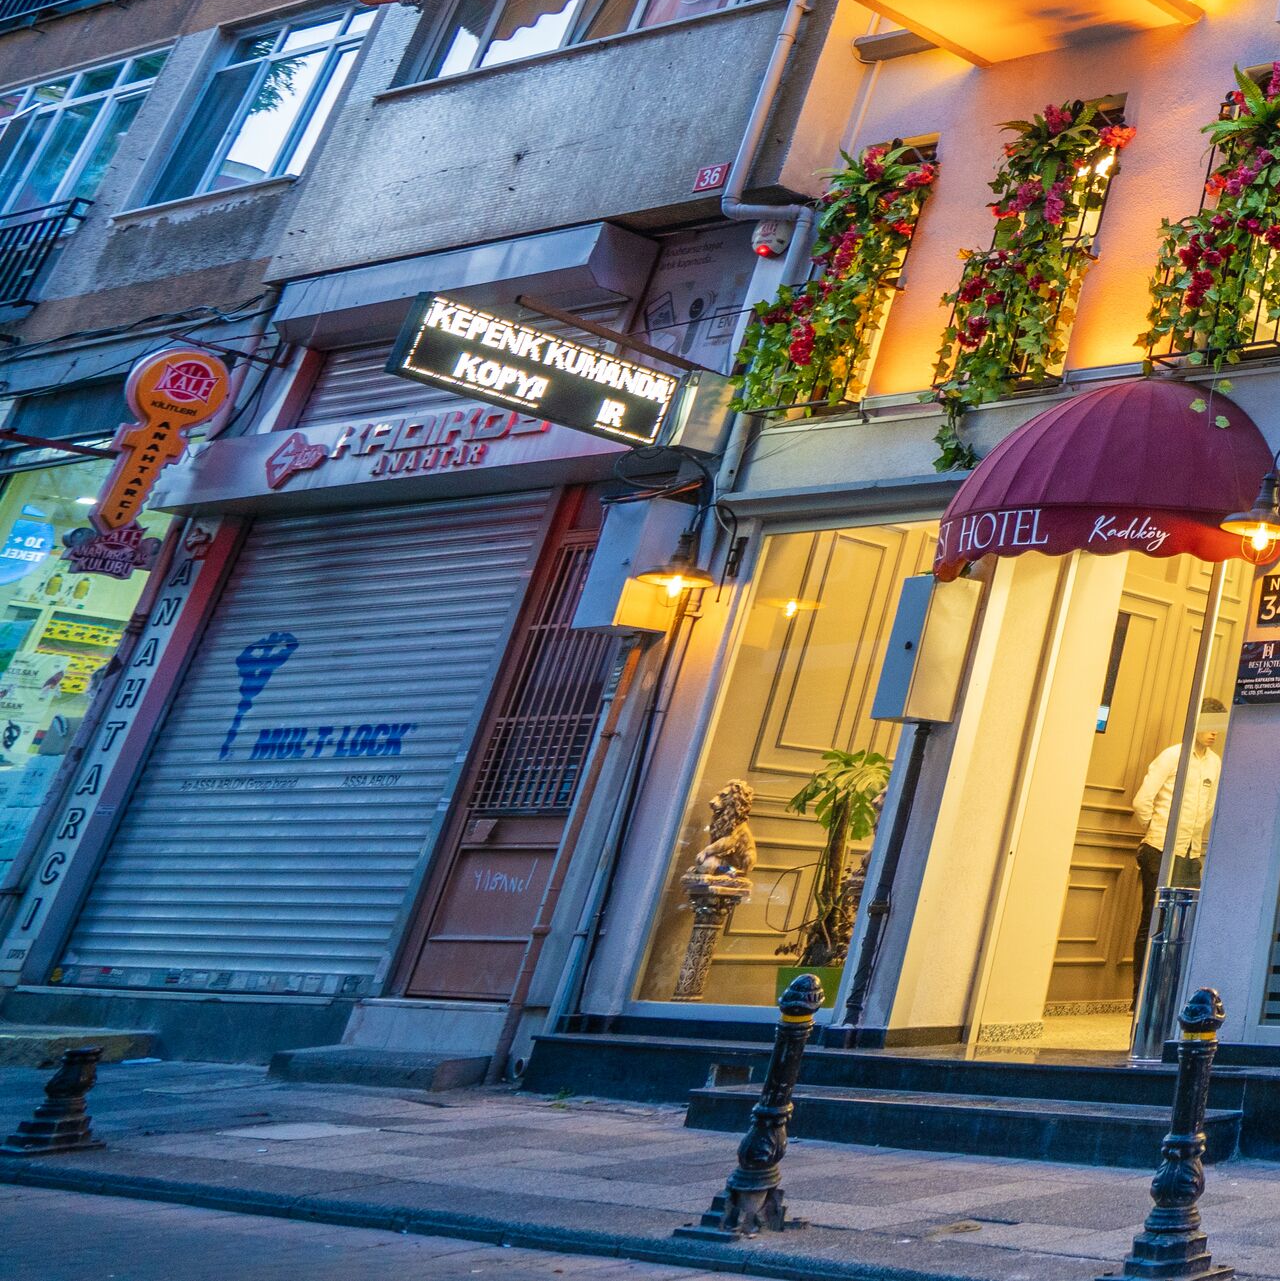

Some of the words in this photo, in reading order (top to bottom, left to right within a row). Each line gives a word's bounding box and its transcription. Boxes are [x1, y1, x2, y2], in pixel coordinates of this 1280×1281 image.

[700, 167, 721, 187] 36
[427, 302, 543, 363] KEPENK
[543, 341, 669, 403] KUMANDA
[159, 369, 216, 401] KALE
[115, 421, 170, 520] ANAHTARCI
[371, 443, 488, 476] ANAHTAR
[958, 509, 1049, 552] HOTEL
[1088, 515, 1170, 551] Kadıköy
[1248, 661, 1264, 669] BEST
[21, 558, 194, 930] ANAHTARCI
[341, 776, 368, 787] ASSA
[368, 774, 401, 786] ABLOY
